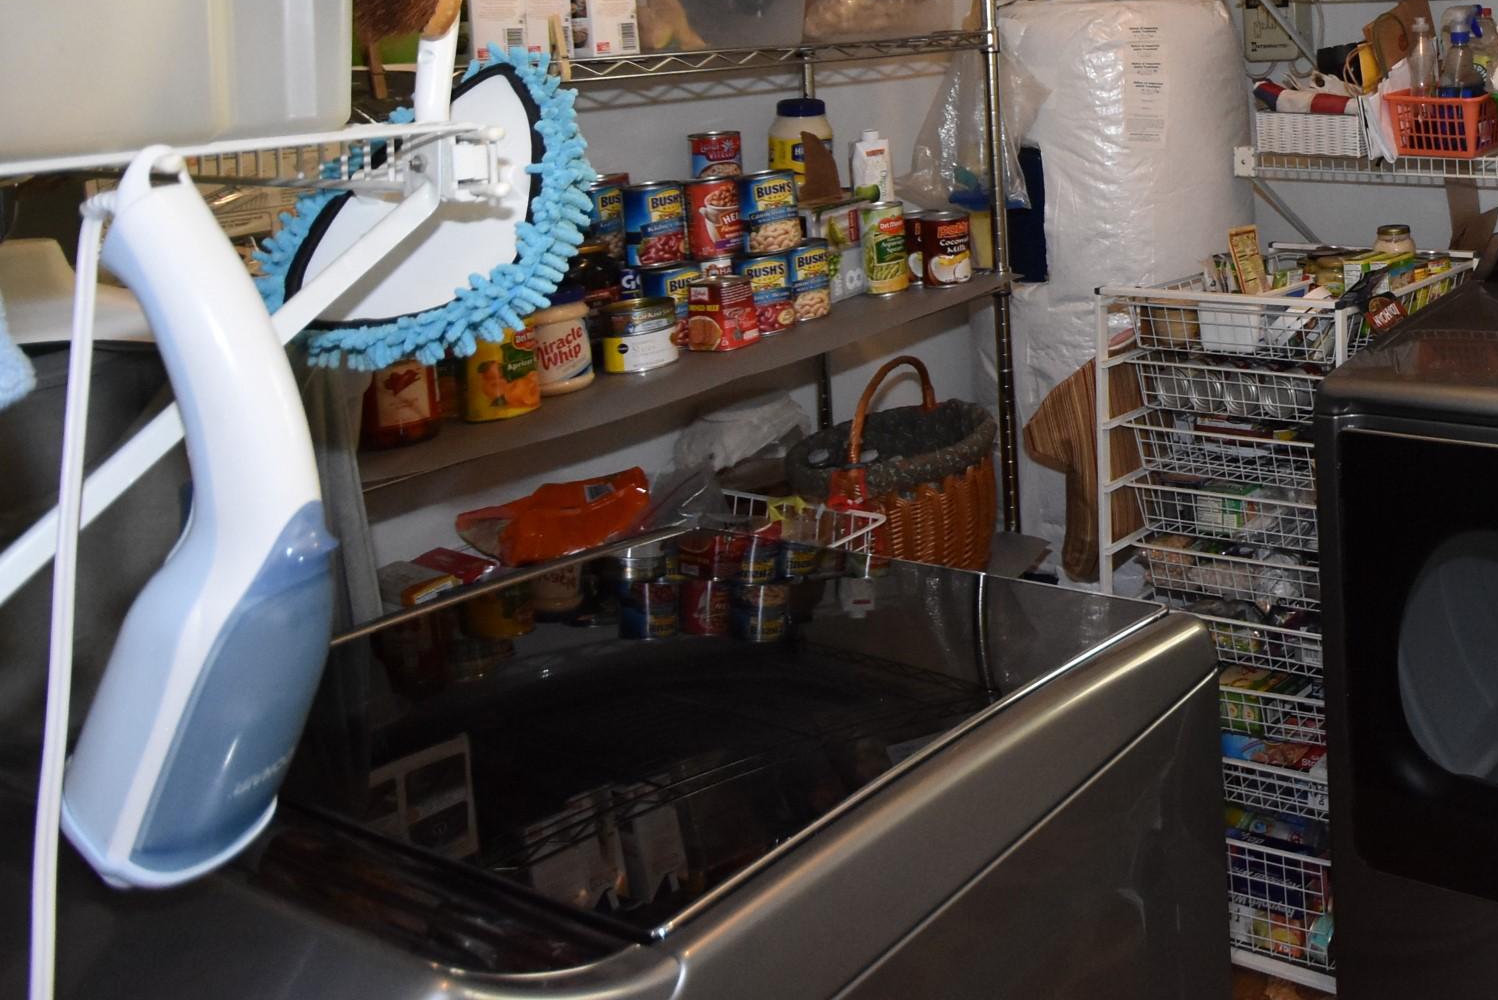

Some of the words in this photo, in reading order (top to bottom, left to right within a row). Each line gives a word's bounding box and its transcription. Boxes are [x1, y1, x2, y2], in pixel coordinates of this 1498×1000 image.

[756, 181, 793, 199] BUSH'S
[601, 195, 621, 208] BUS
[746, 263, 785, 279] BUSH'S
[669, 275, 692, 294] BUS
[535, 326, 583, 362] Miracle
[541, 343, 581, 370] Whip
